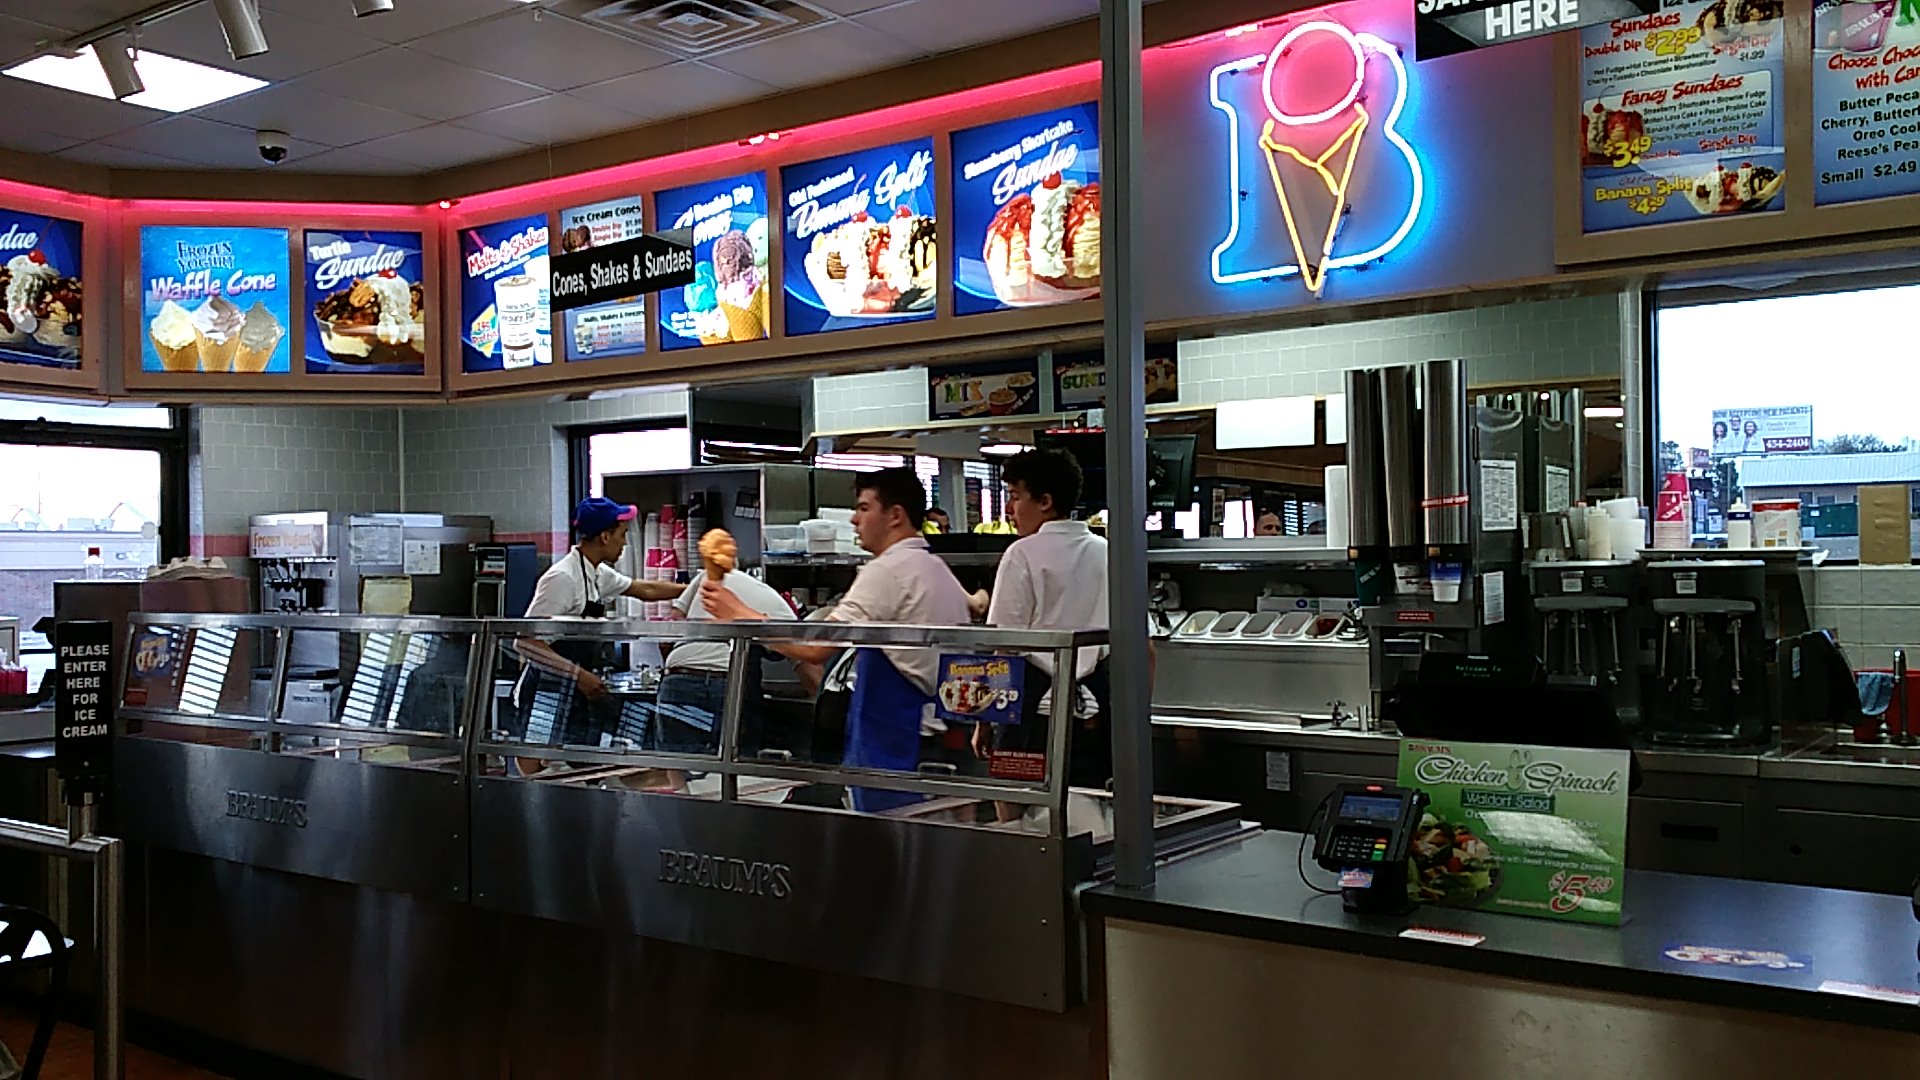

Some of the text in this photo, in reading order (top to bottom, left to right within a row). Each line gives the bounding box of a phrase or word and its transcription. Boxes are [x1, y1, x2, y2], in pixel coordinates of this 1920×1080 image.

[1485, 0, 1579, 40] HERE
[1610, 12, 1681, 37] Sundaes
[1585, 27, 1701, 58] Double Dip $2.99
[1674, 52, 1710, 62] Strawberry
[1828, 54, 1878, 70] Choose
[1856, 69, 1889, 89] with
[1621, 75, 1744, 107] Fancy Sundaes
[1840, 97, 1882, 112] Butter
[1821, 115, 1869, 130] Cherry,
[1021, 120, 1074, 153] Shortcake
[1853, 130, 1886, 141] Oreo
[1603, 136, 1652, 168] $3.49
[1837, 142, 1890, 160] Reese's
[992, 140, 1079, 205] Sundae
[1821, 161, 1917, 185] Small $2.49
[732, 185, 754, 206] Dip
[789, 187, 808, 207] Old
[791, 190, 870, 239] Banana
[874, 150, 933, 211] Split
[1595, 177, 1694, 201] Banana Split
[572, 204, 641, 224] Ice Cream Cones
[309, 241, 352, 261] Turtle
[467, 246, 500, 278] Malts
[510, 227, 548, 257] Shakes
[315, 244, 405, 290] Sundae
[552, 247, 693, 296] Cones, Shakes & Sundaes
[151, 269, 276, 300] Waffle Cone
[944, 380, 984, 403] MIX
[253, 532, 280, 548] Frozen
[61, 644, 109, 657] PLEASE
[64, 661, 106, 673] ENTER
[950, 660, 1009, 677] Banana Split
[66, 677, 100, 689] HERE
[73, 693, 98, 705] FOR
[75, 709, 96, 721] ICE
[63, 724, 107, 738] CREAM
[1415, 754, 1507, 786] Chicken
[1524, 761, 1620, 797] Spinach
[226, 790, 308, 828] BRAUM'S
[1467, 792, 1550, 811] Waldorf Salad
[659, 848, 792, 899] BRAUM'S
